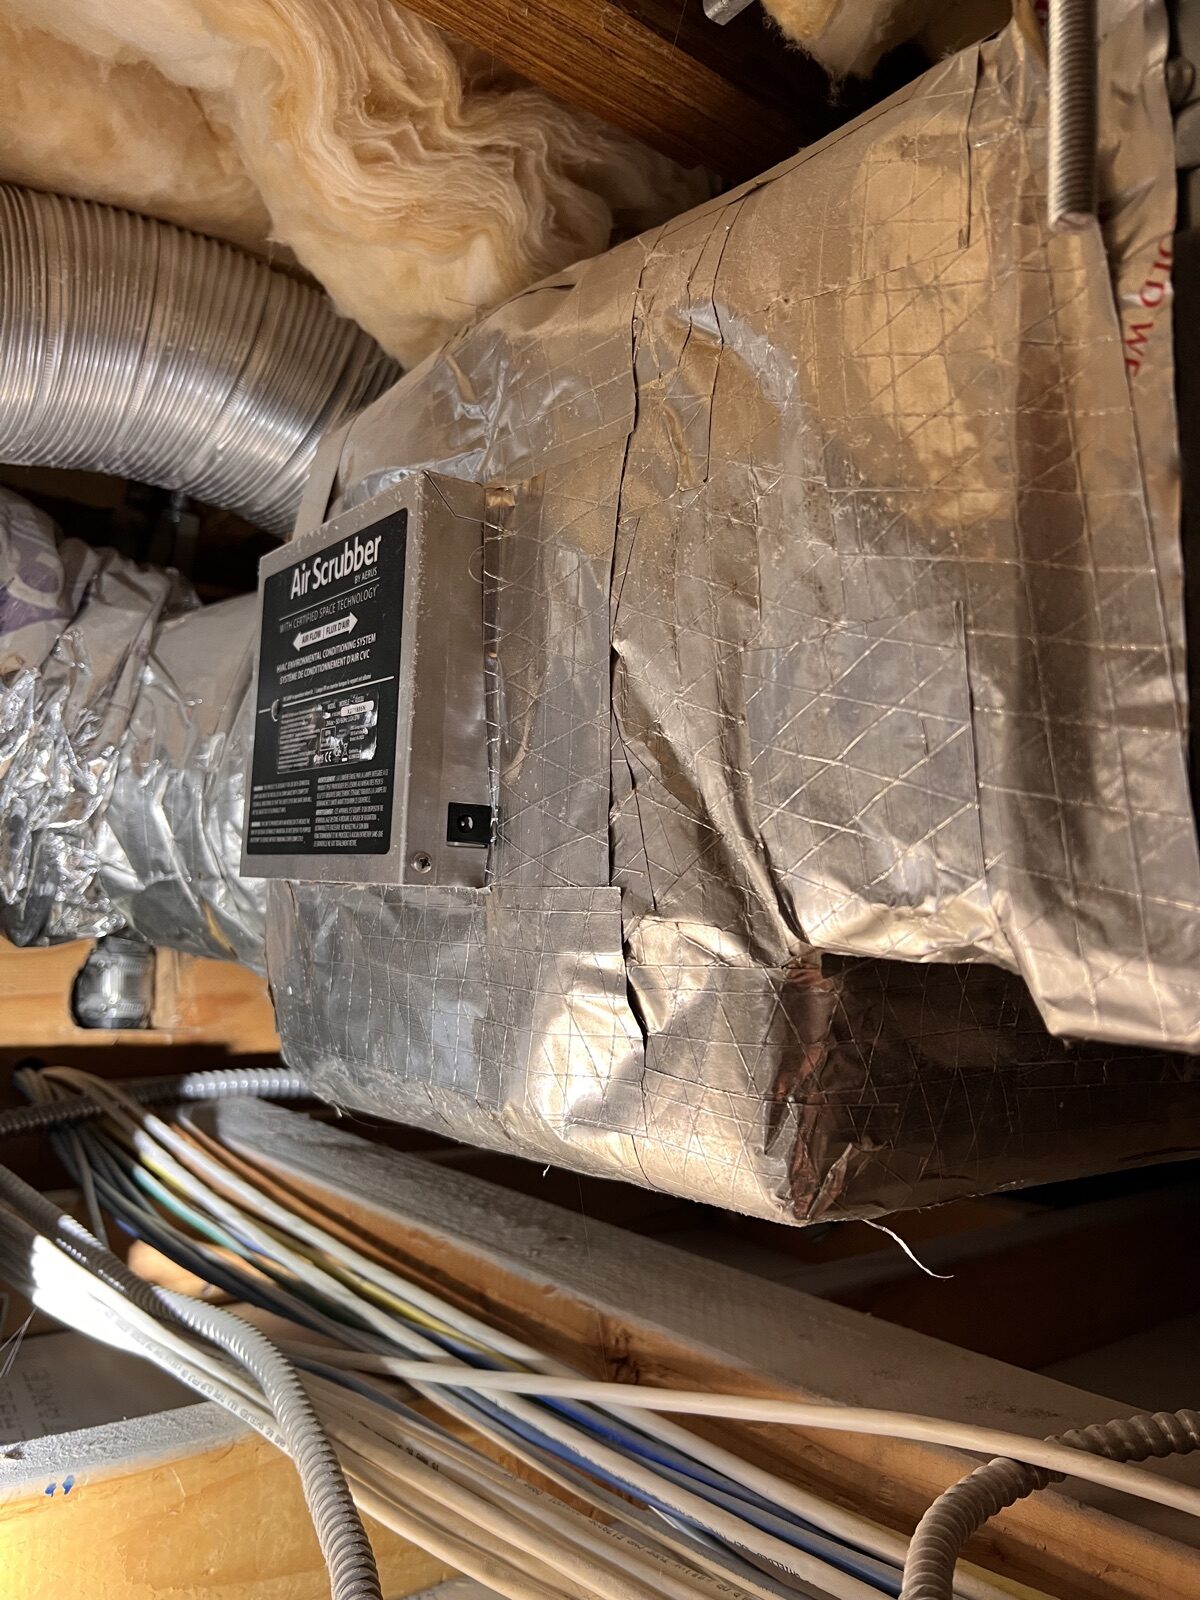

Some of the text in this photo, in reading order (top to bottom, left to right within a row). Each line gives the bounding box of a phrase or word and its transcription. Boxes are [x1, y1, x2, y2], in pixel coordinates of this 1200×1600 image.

[291, 535, 382, 600] Air Scrubber
[354, 567, 378, 584] BY AERUS
[280, 621, 292, 633] WITH
[293, 610, 318, 628] CERTIFIED
[319, 603, 336, 619] SPACE
[310, 629, 321, 641] FLOW
[326, 624, 337, 636] FLUX
[287, 652, 322, 669] ENVIRONMENTAL
[322, 640, 356, 658] CONDITIONING
[357, 633, 376, 649] SYSTEM
[298, 670, 304, 679] DE
[304, 658, 346, 677] CONDITIONNEMENT
[359, 649, 370, 661] CVC
